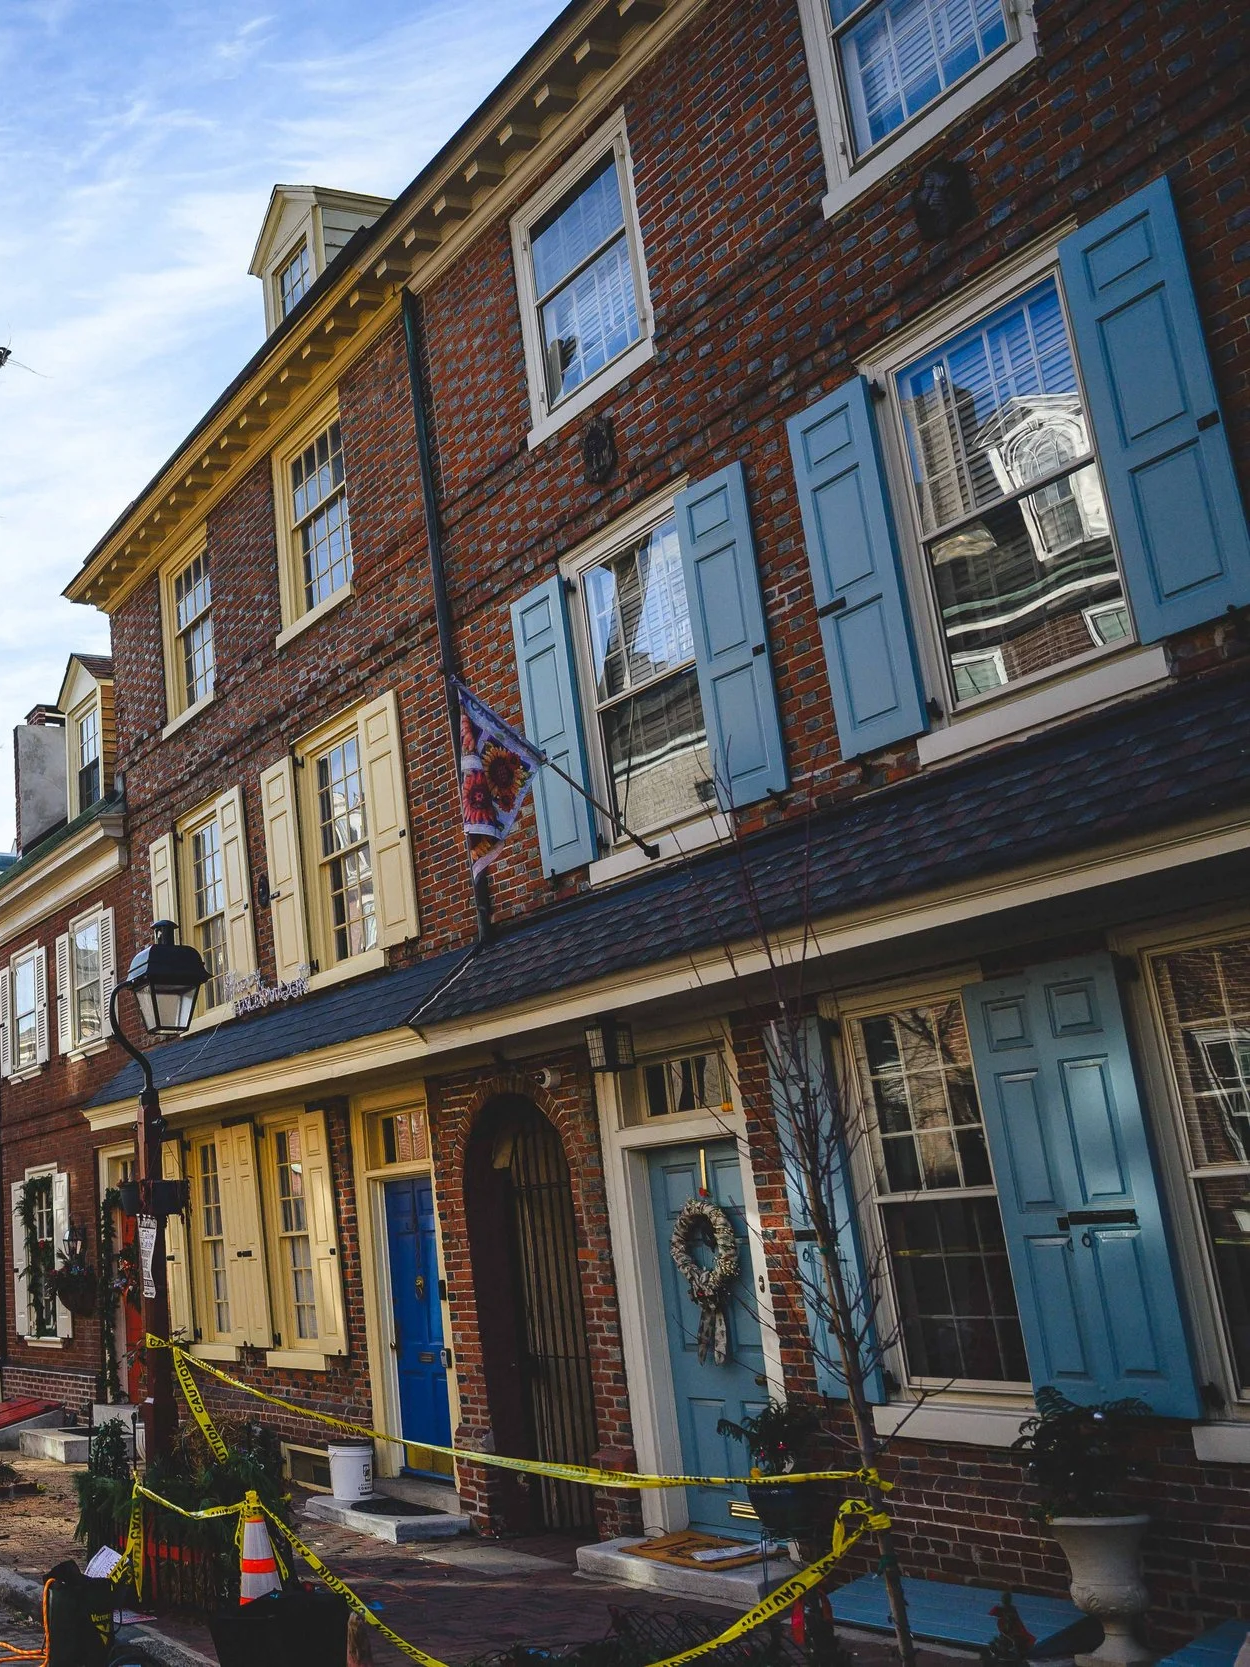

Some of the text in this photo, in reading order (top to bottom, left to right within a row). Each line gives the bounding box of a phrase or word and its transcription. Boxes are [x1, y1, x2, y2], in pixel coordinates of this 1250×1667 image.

[176, 1359, 203, 1413] CAUTION
[203, 1423, 227, 1460] UTION
[741, 1581, 807, 1629] CAUTION
[375, 1623, 429, 1662] CAUTION
